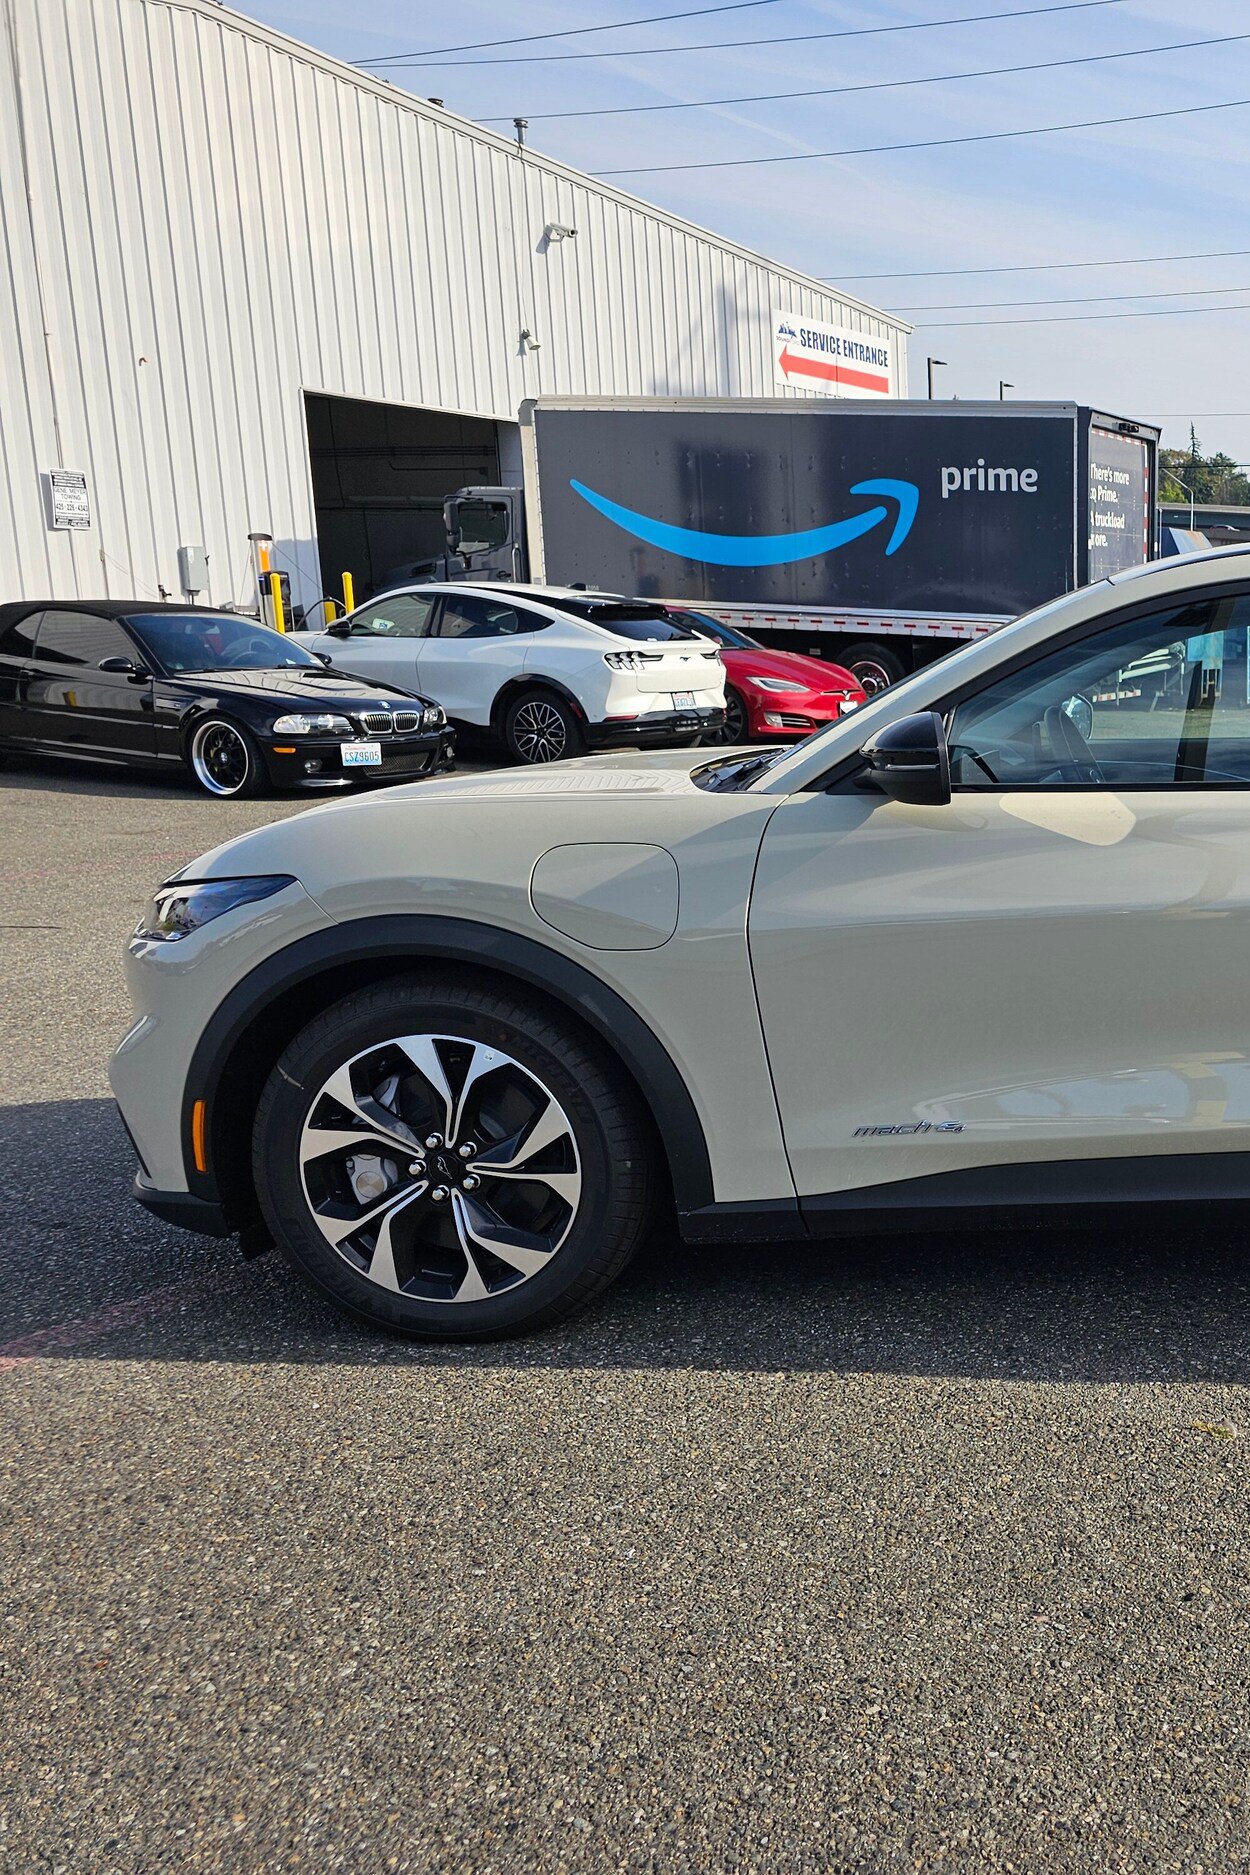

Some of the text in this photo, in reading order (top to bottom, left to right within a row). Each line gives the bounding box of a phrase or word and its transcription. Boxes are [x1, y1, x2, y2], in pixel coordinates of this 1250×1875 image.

[800, 328, 888, 367] SERVICE ENTRANCE
[942, 458, 1038, 498] prime
[1114, 472, 1129, 485] more
[1098, 485, 1118, 503] Prime.
[1095, 512, 1124, 529] truckload
